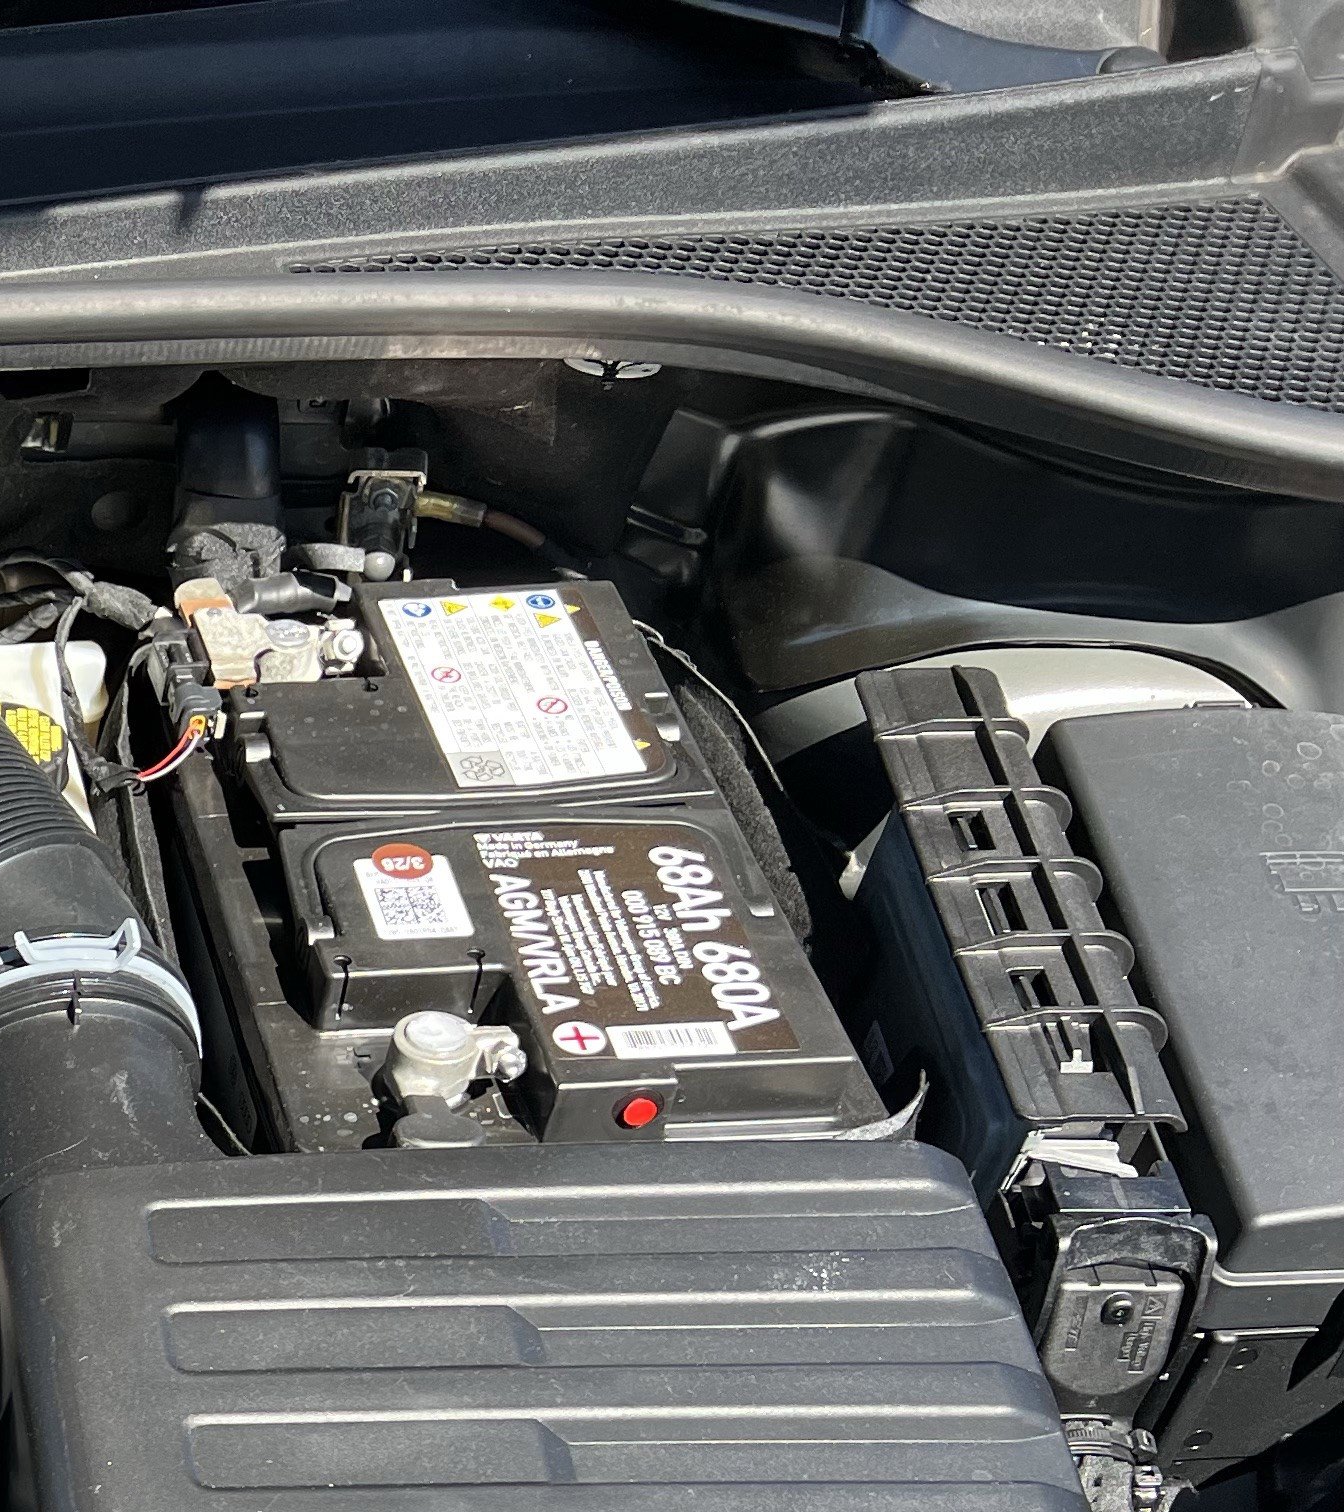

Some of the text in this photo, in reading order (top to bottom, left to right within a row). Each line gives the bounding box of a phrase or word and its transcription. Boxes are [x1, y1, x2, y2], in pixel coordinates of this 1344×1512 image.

[647, 844, 736, 932] 68Ah
[489, 872, 583, 1015] AGM/VRLA
[629, 913, 663, 939] 915
[651, 963, 685, 985] BC
[691, 938, 780, 1032] 680A
